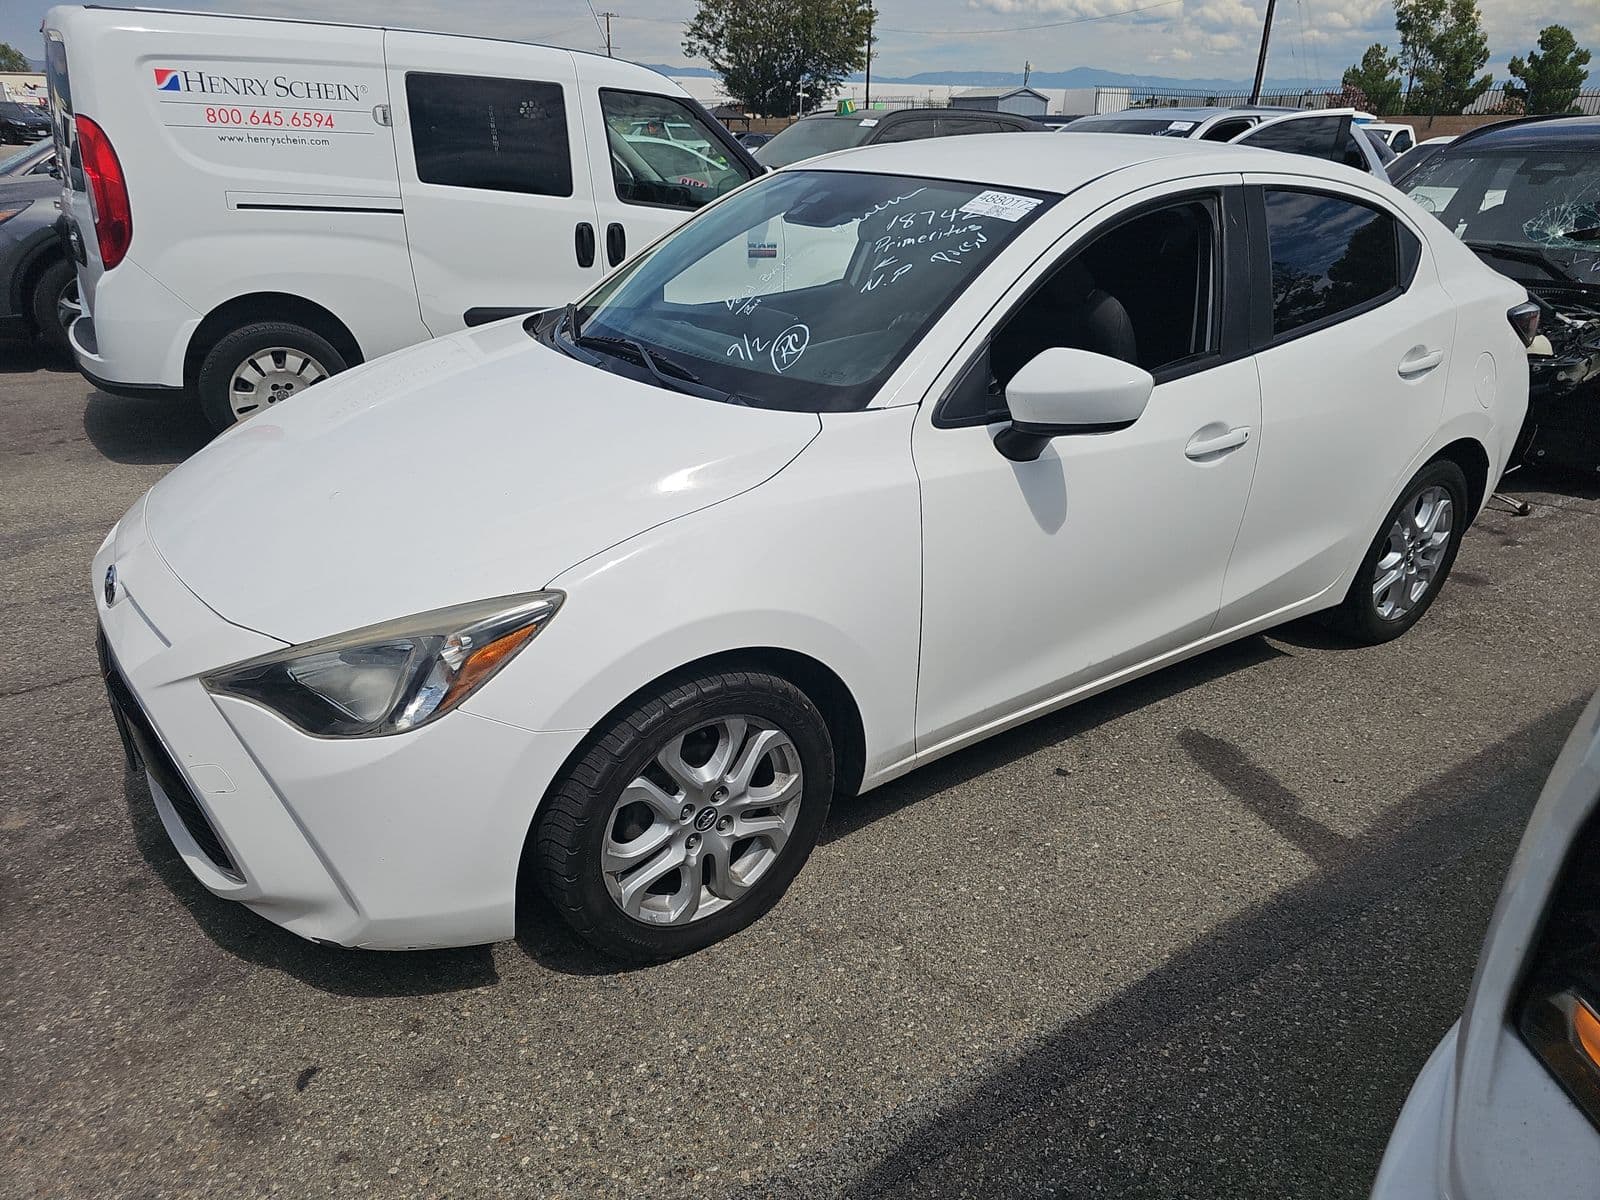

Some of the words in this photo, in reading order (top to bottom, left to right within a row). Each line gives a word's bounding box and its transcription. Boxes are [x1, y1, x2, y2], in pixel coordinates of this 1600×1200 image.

[180, 70, 269, 97] HENRY
[206, 107, 336, 129] 800.645.6594
[217, 133, 331, 147] www.henryschein.com
